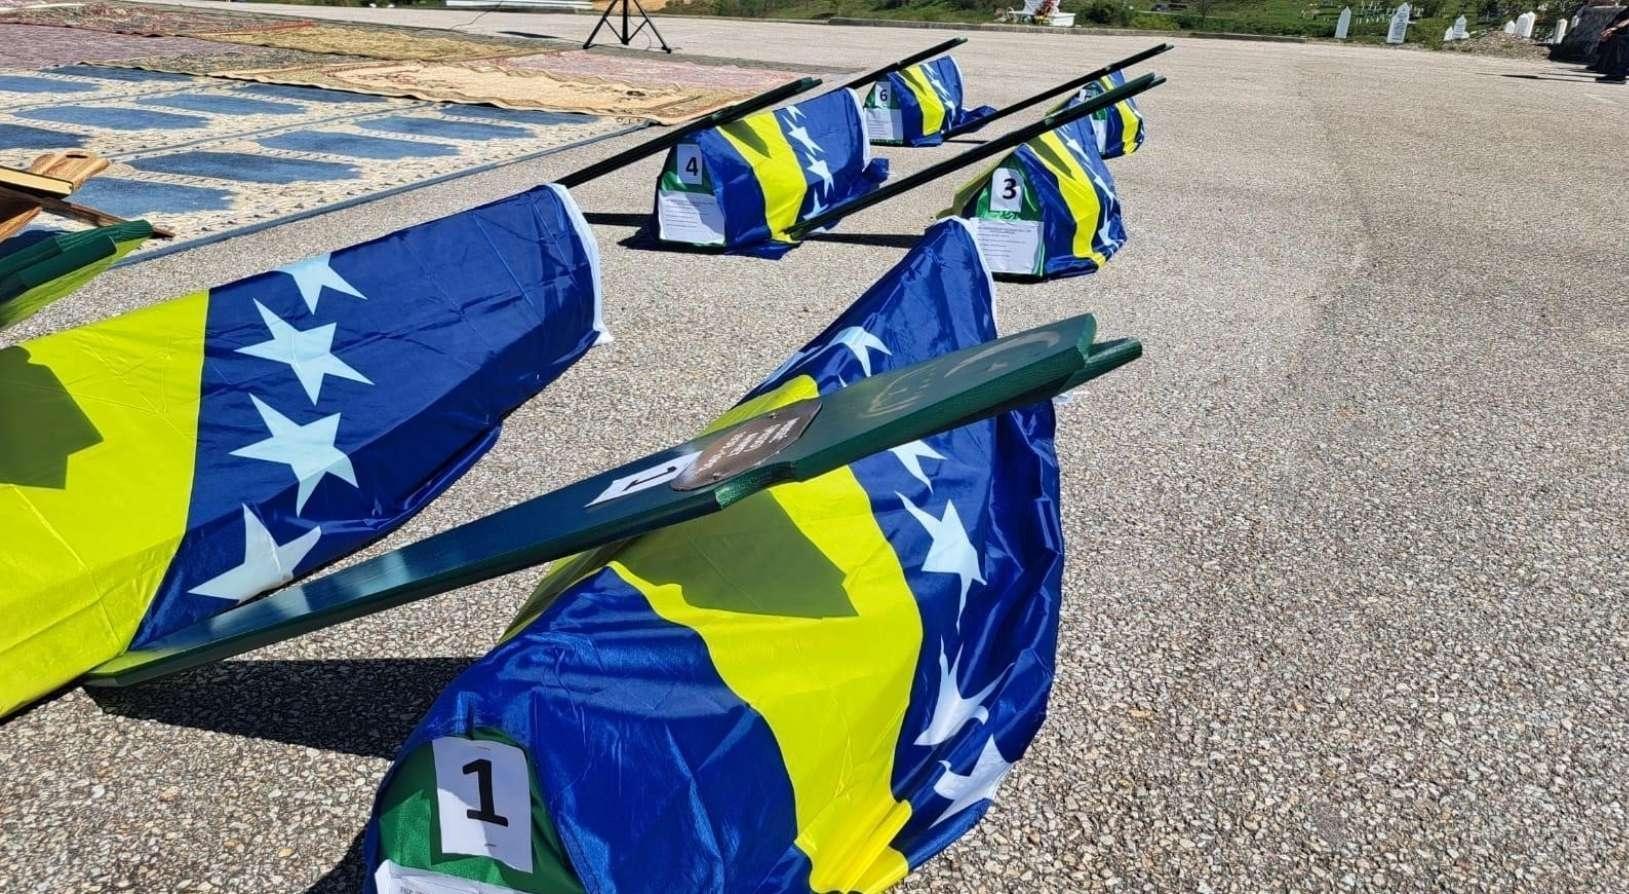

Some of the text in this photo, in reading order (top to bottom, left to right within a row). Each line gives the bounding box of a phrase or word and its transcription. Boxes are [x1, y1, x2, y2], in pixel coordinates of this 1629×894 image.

[880, 89, 888, 101] 6
[686, 157, 698, 176] 4
[1002, 178, 1017, 199] 3
[462, 759, 509, 827] 1
